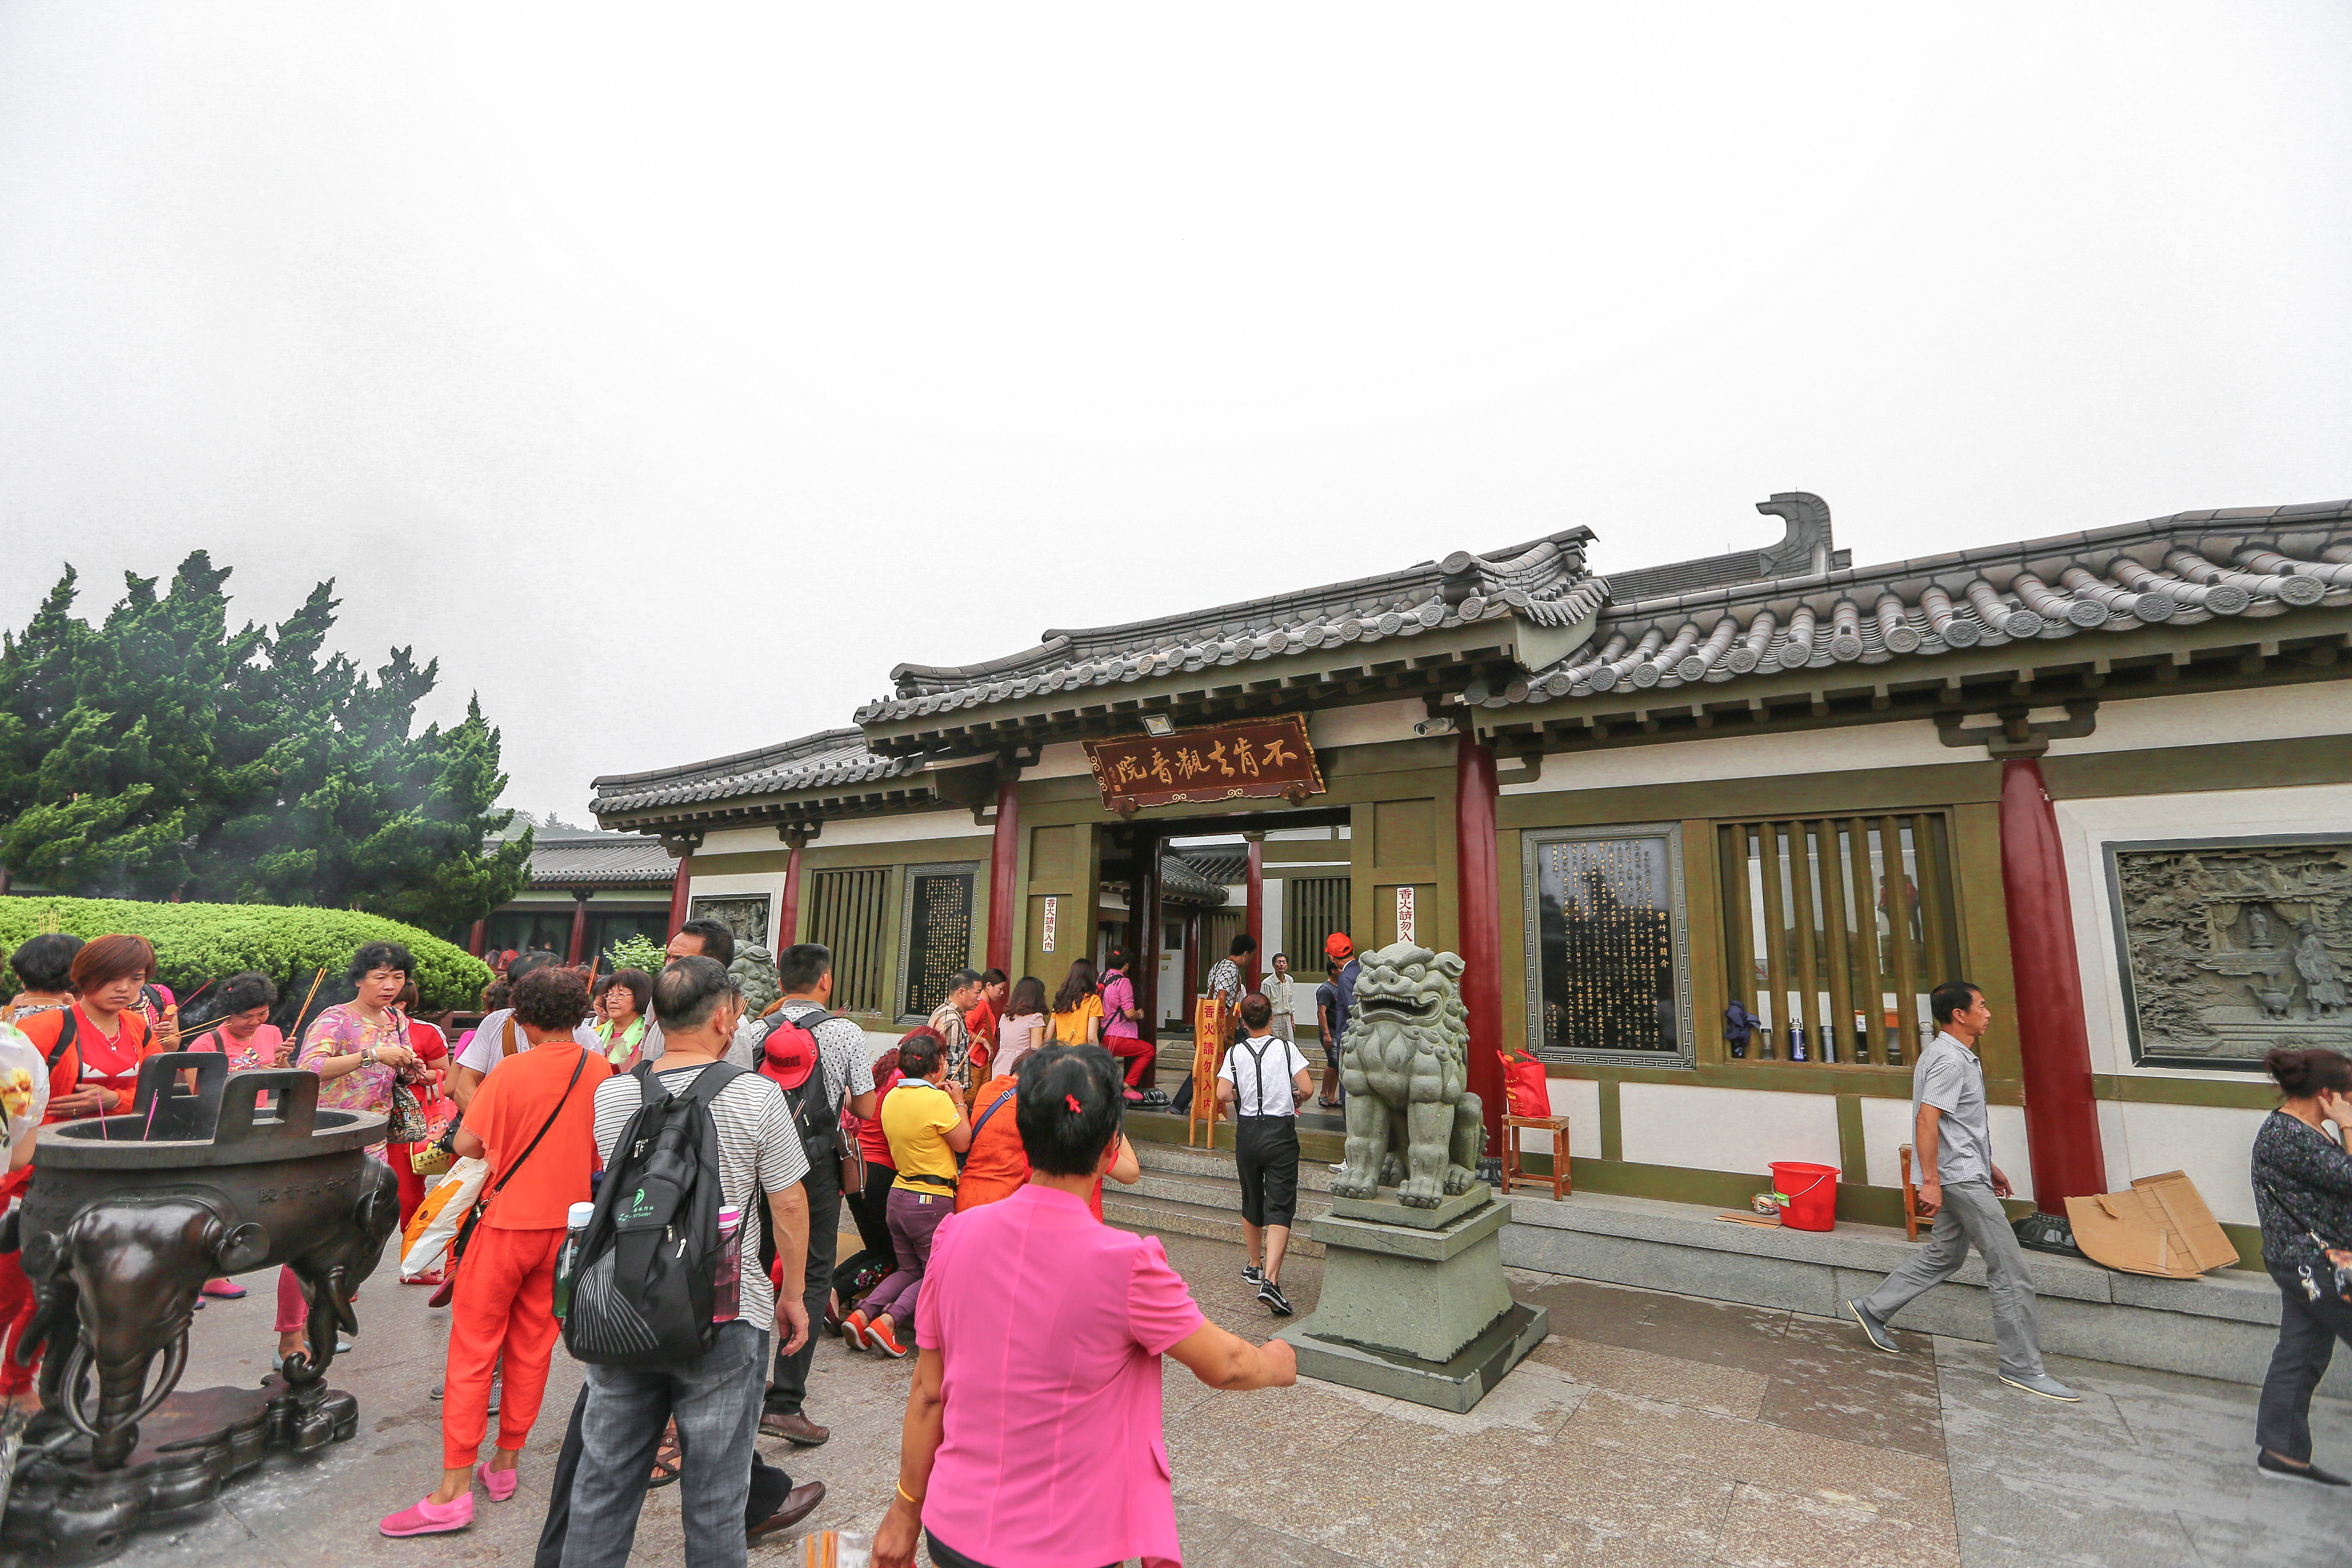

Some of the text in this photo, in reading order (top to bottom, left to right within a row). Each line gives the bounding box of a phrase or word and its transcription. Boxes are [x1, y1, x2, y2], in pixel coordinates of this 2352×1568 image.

[1658, 911, 1669, 968] 紫竹林簡介
